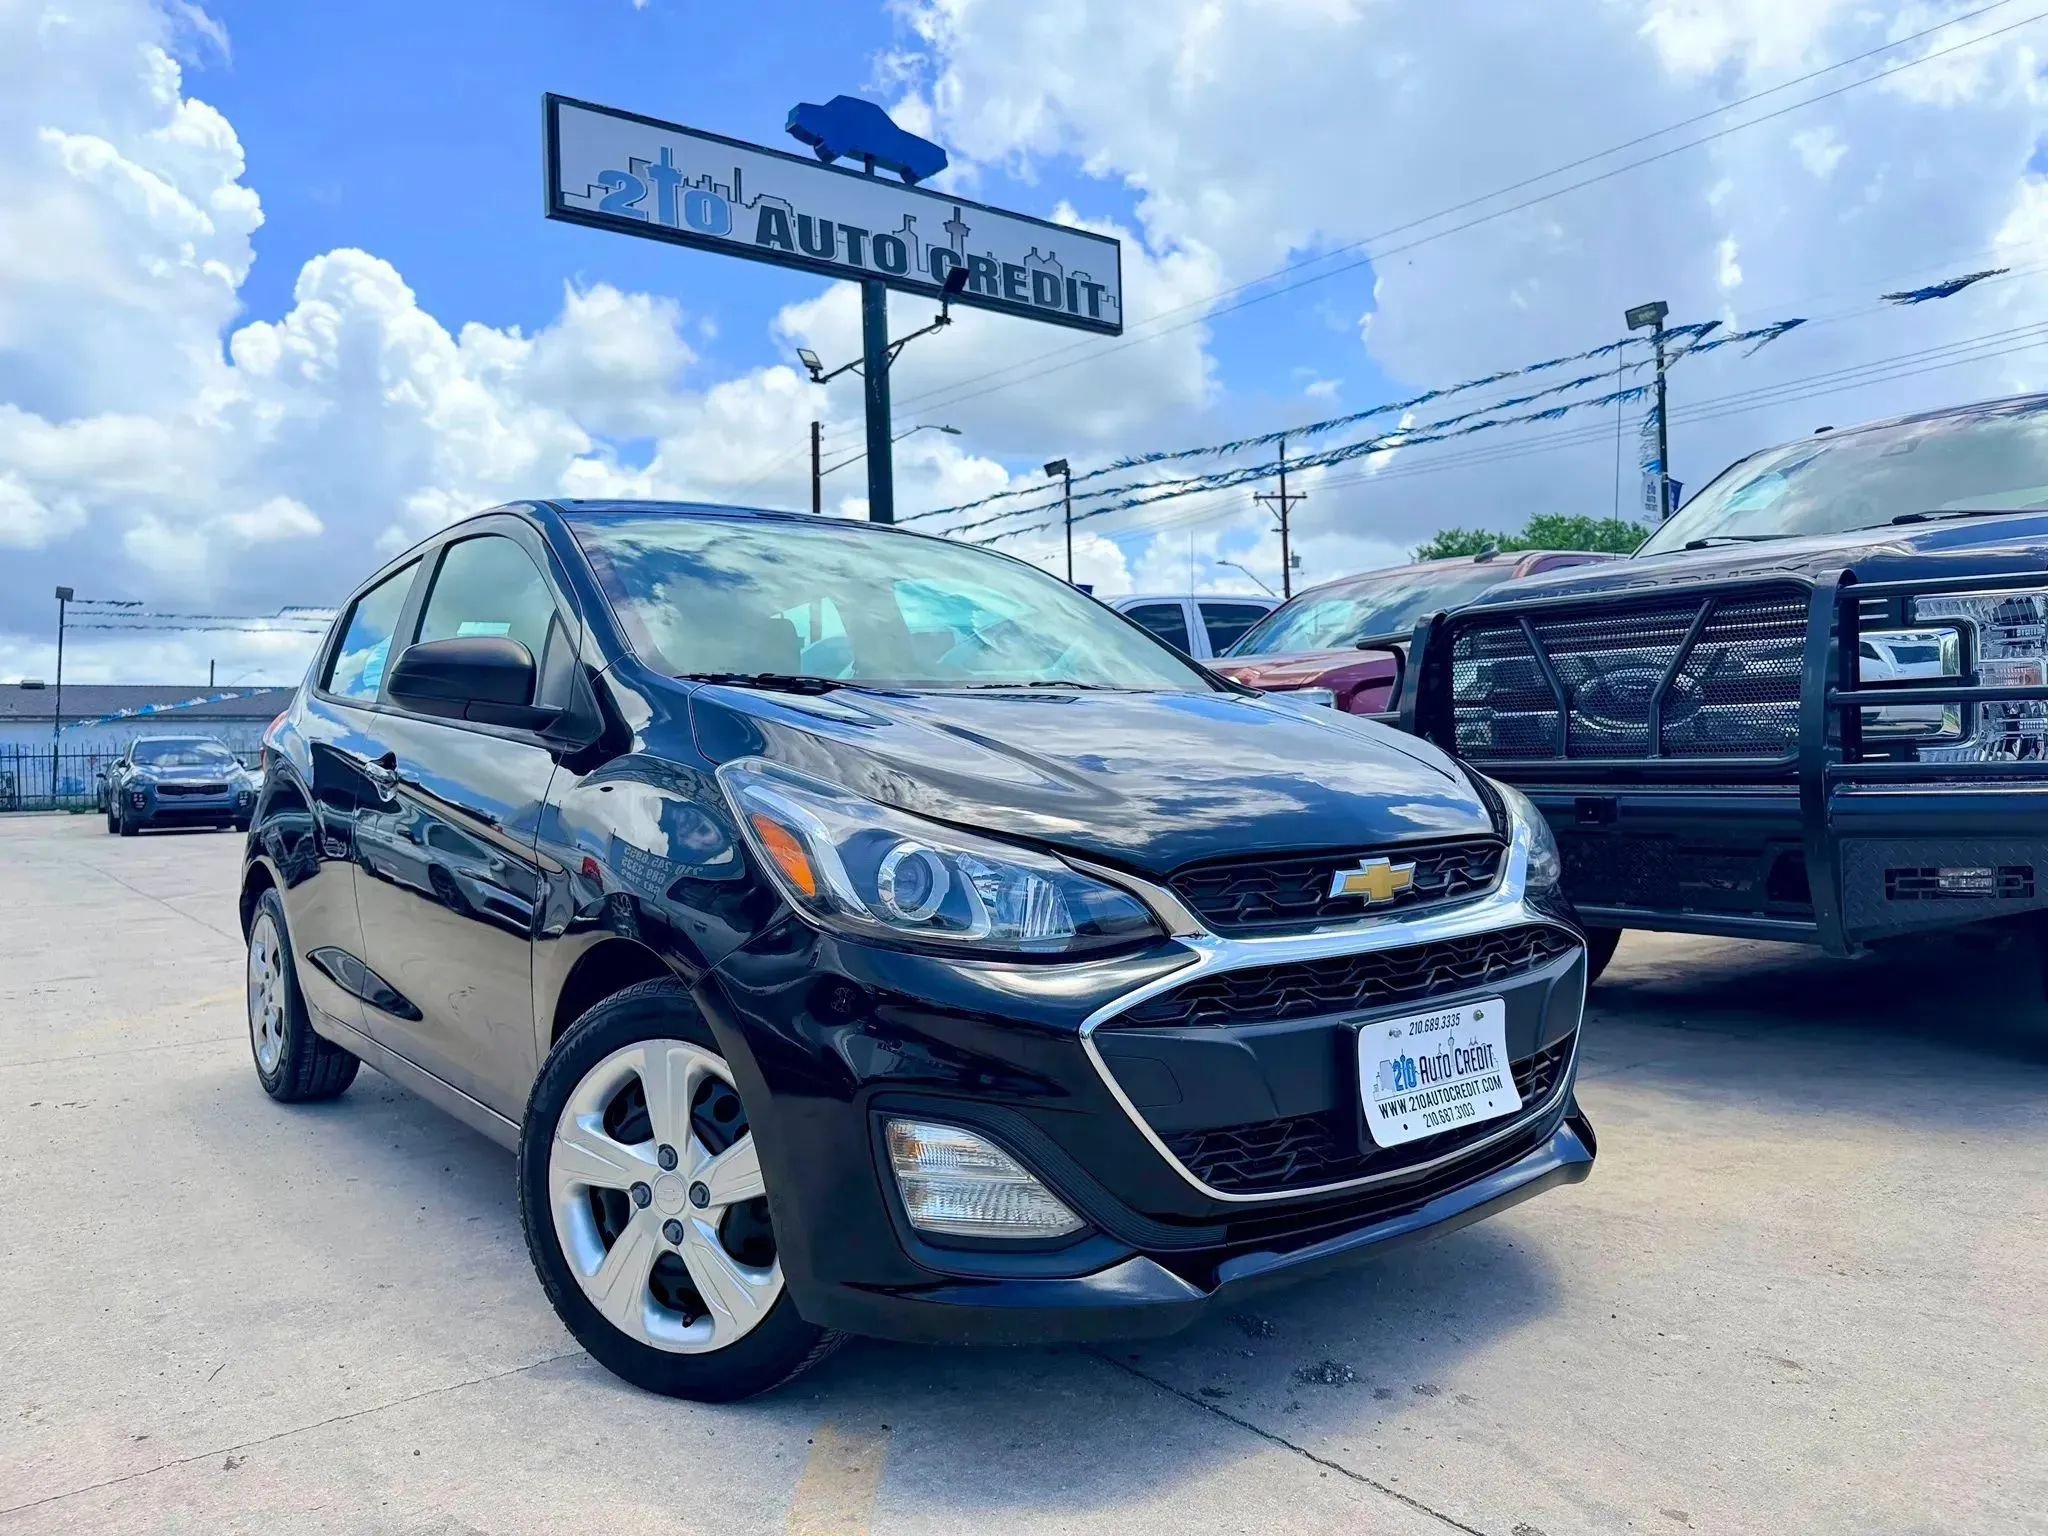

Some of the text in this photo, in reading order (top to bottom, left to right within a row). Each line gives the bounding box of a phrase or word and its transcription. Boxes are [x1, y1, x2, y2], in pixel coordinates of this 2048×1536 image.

[598, 147, 1107, 319] 210 AUTO CREDIT
[1409, 1013, 1460, 1036] 210.689.3335
[1392, 1056, 1417, 1091] 210
[1378, 1075, 1503, 1120] WWW.210AUTOCREDIT.COM
[1422, 1102, 1476, 1128] 210.687.3103
